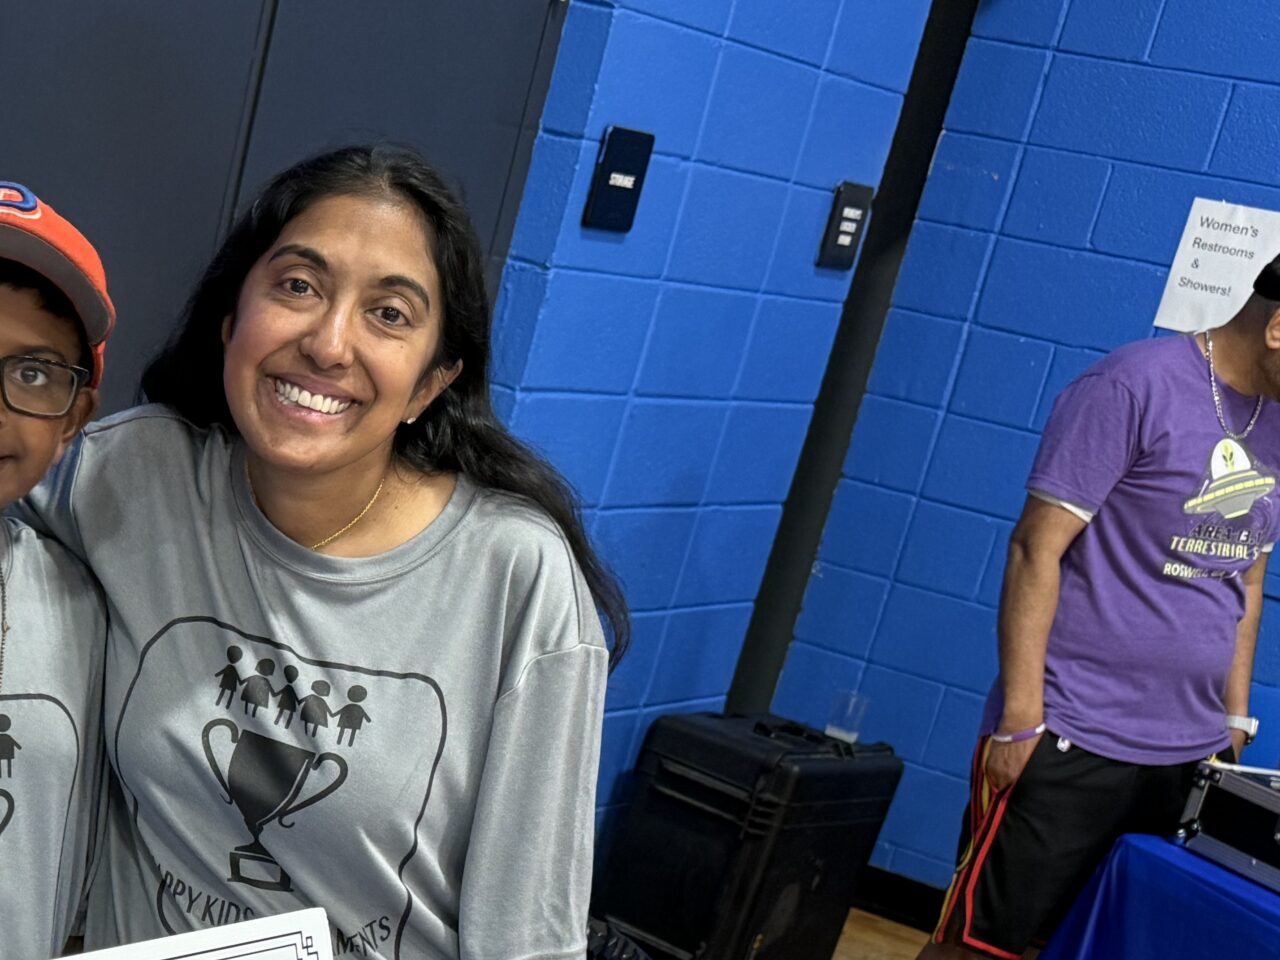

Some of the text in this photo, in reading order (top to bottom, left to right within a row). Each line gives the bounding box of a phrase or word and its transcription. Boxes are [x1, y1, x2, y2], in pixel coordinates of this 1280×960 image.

[1199, 216, 1259, 238] Women's
[1192, 237, 1255, 260] Restrooms
[1190, 258, 1200, 269] &
[1178, 276, 1232, 297] Showers!
[1170, 536, 1249, 560] TERRESTRIAL
